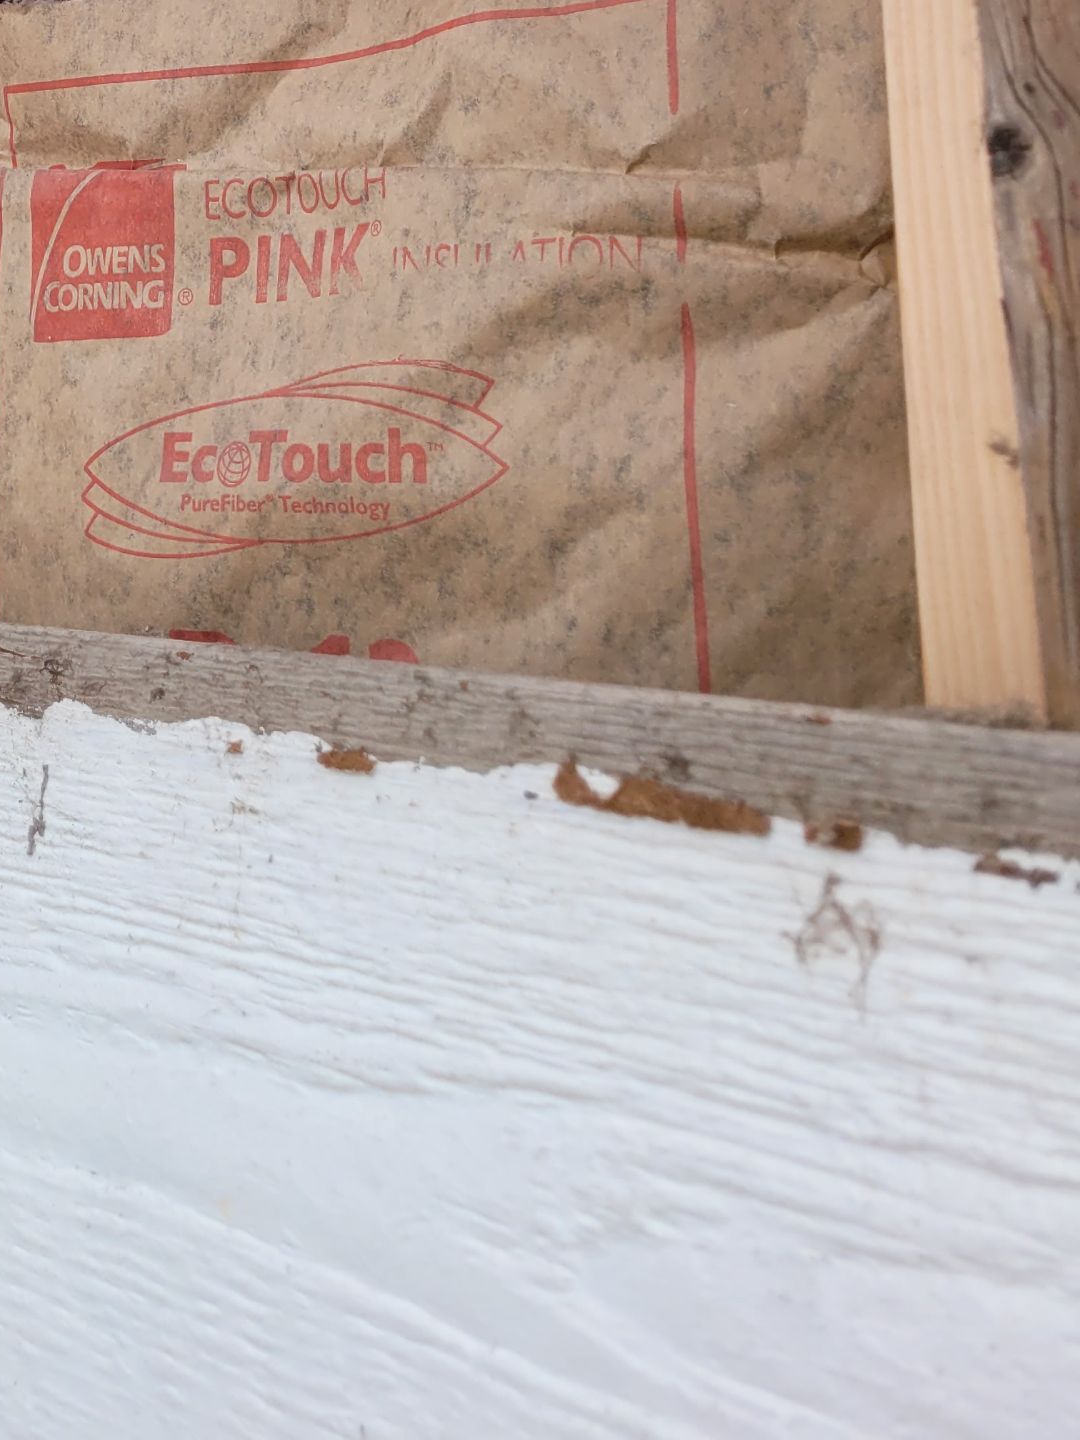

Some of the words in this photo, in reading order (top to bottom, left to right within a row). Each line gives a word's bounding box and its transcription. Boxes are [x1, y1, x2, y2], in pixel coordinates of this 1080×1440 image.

[204, 167, 387, 220] ECOTOUCH
[63, 244, 166, 278] OWENS
[43, 280, 166, 313] CORNING
[278, 494, 391, 521] Technology
